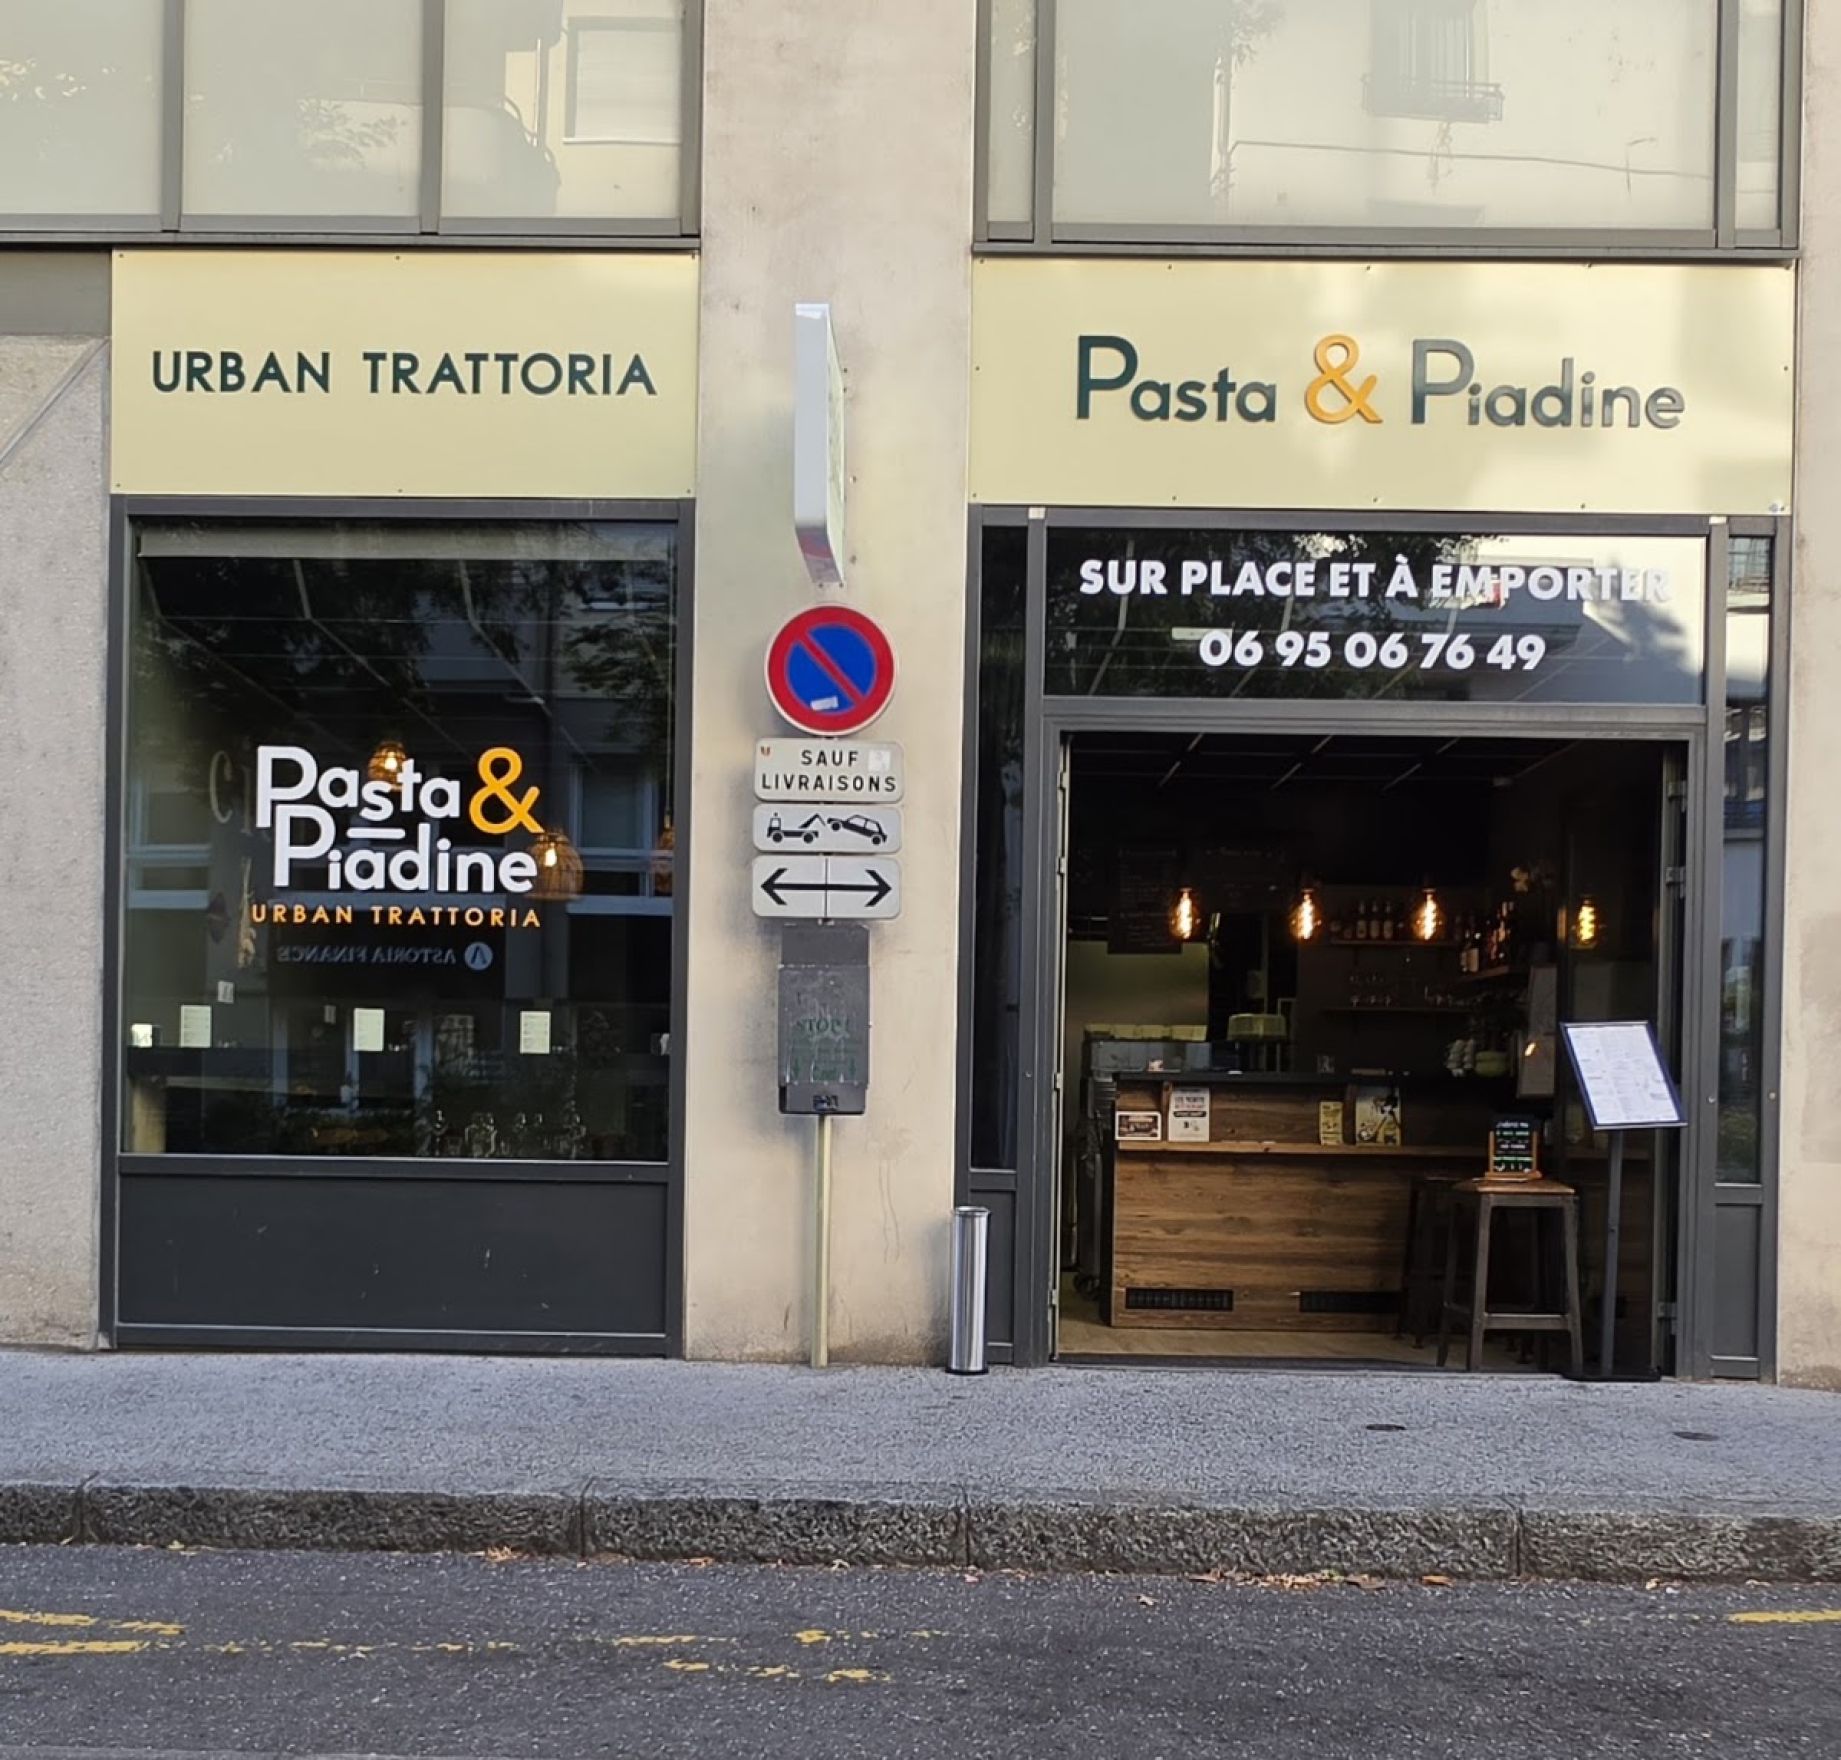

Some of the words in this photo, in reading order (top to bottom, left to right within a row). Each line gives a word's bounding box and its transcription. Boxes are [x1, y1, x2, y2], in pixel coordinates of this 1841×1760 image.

[152, 350, 331, 393] URBAN
[362, 351, 657, 396] TRATTORIA
[1075, 334, 1277, 422] Pasta
[1304, 333, 1383, 424] &
[1411, 338, 1686, 429] Piadine
[1079, 558, 1166, 596] SUR
[1180, 560, 1315, 598] PLACE
[1329, 562, 1376, 598] ET
[1386, 554, 1418, 599] À
[1430, 564, 1670, 601] EMPORTER
[1200, 631, 1263, 668] 06
[1275, 632, 1331, 669] 95
[1343, 633, 1408, 669] 06
[1420, 634, 1475, 670] 76
[1486, 635, 1546, 671] 49
[801, 750, 858, 767] SAUF
[255, 745, 461, 829] Pasta
[468, 746, 545, 835] &
[761, 774, 896, 792] LIVRAISONS
[273, 803, 538, 894] Piadine
[251, 904, 353, 924] URBAN
[370, 906, 541, 928] TRATTORIA
